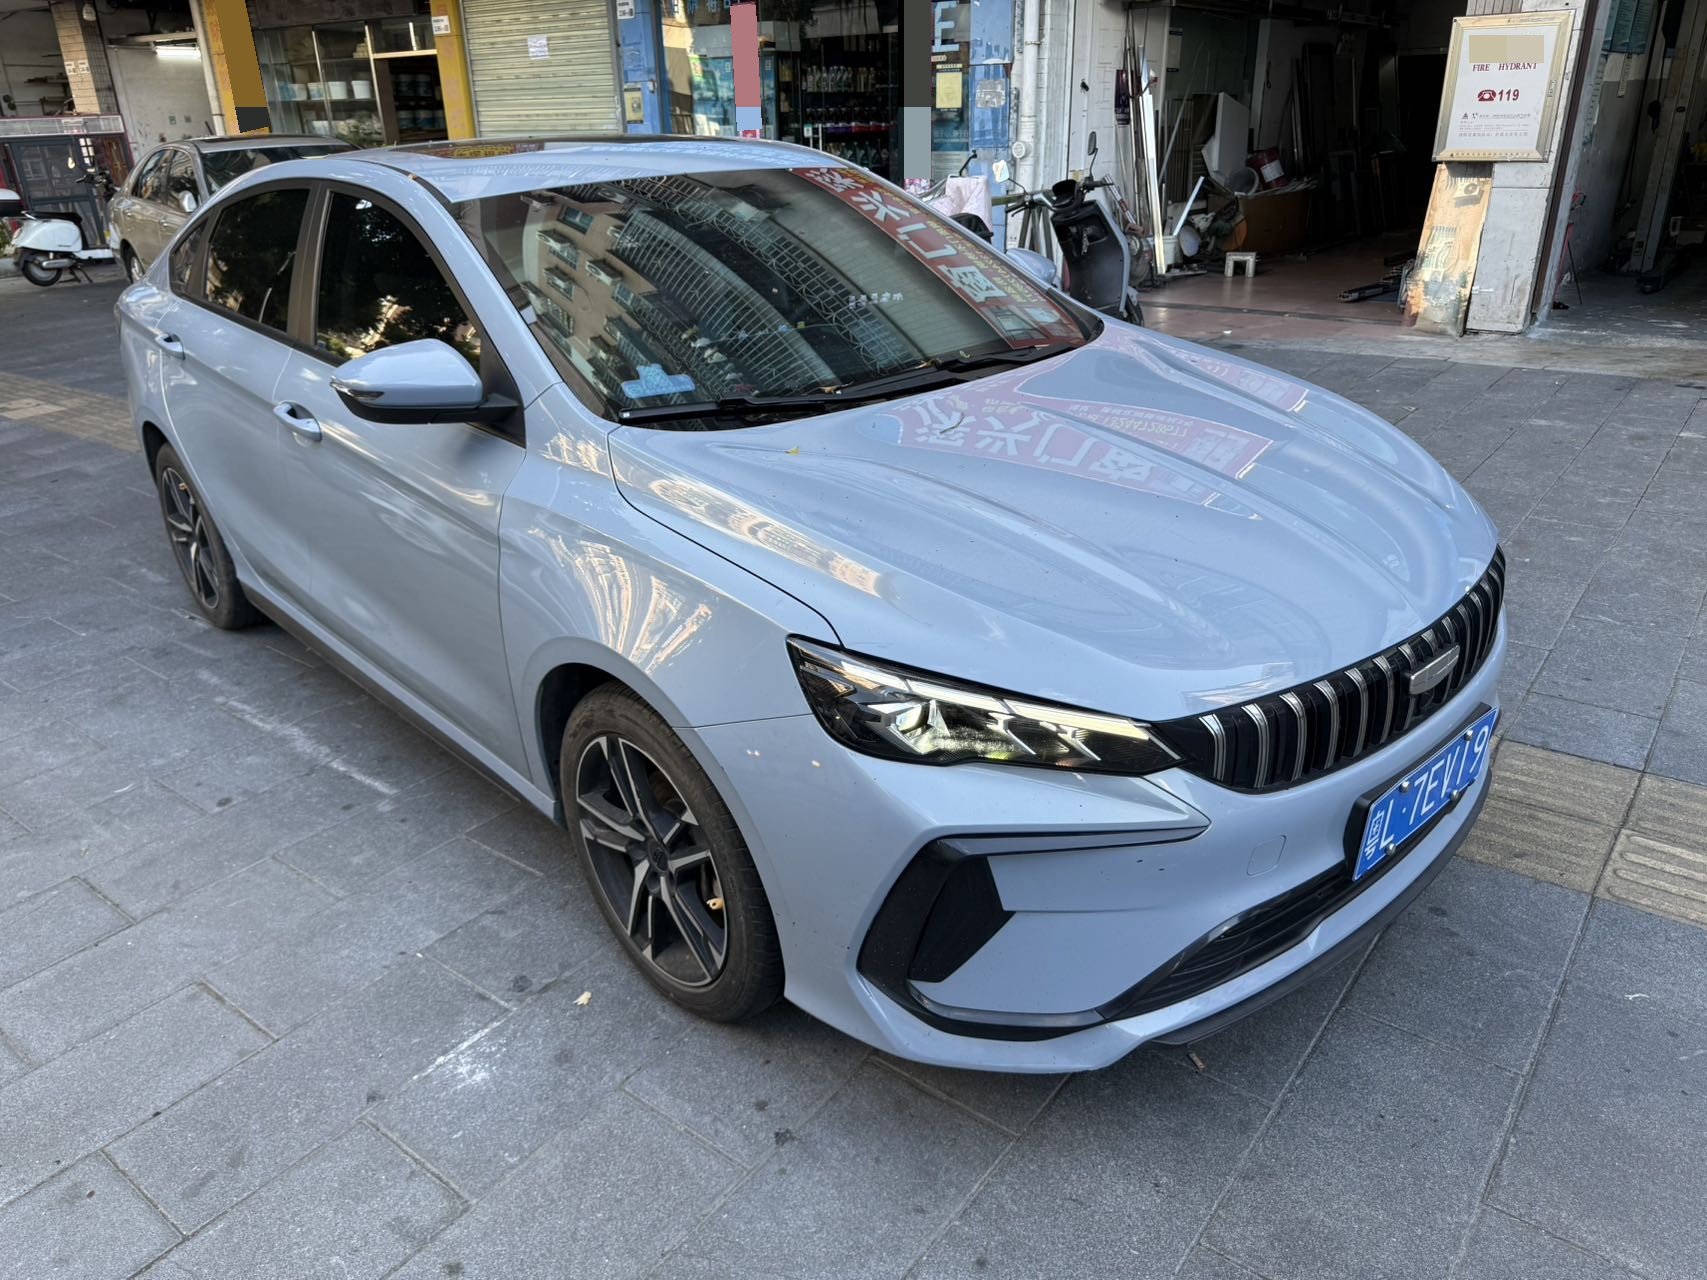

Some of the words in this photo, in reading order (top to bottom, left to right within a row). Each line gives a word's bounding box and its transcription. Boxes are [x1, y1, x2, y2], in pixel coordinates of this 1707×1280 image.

[1472, 64, 1491, 72] FIRE
[1498, 62, 1537, 71] HYDRANT
[1498, 88, 1520, 102] 119
